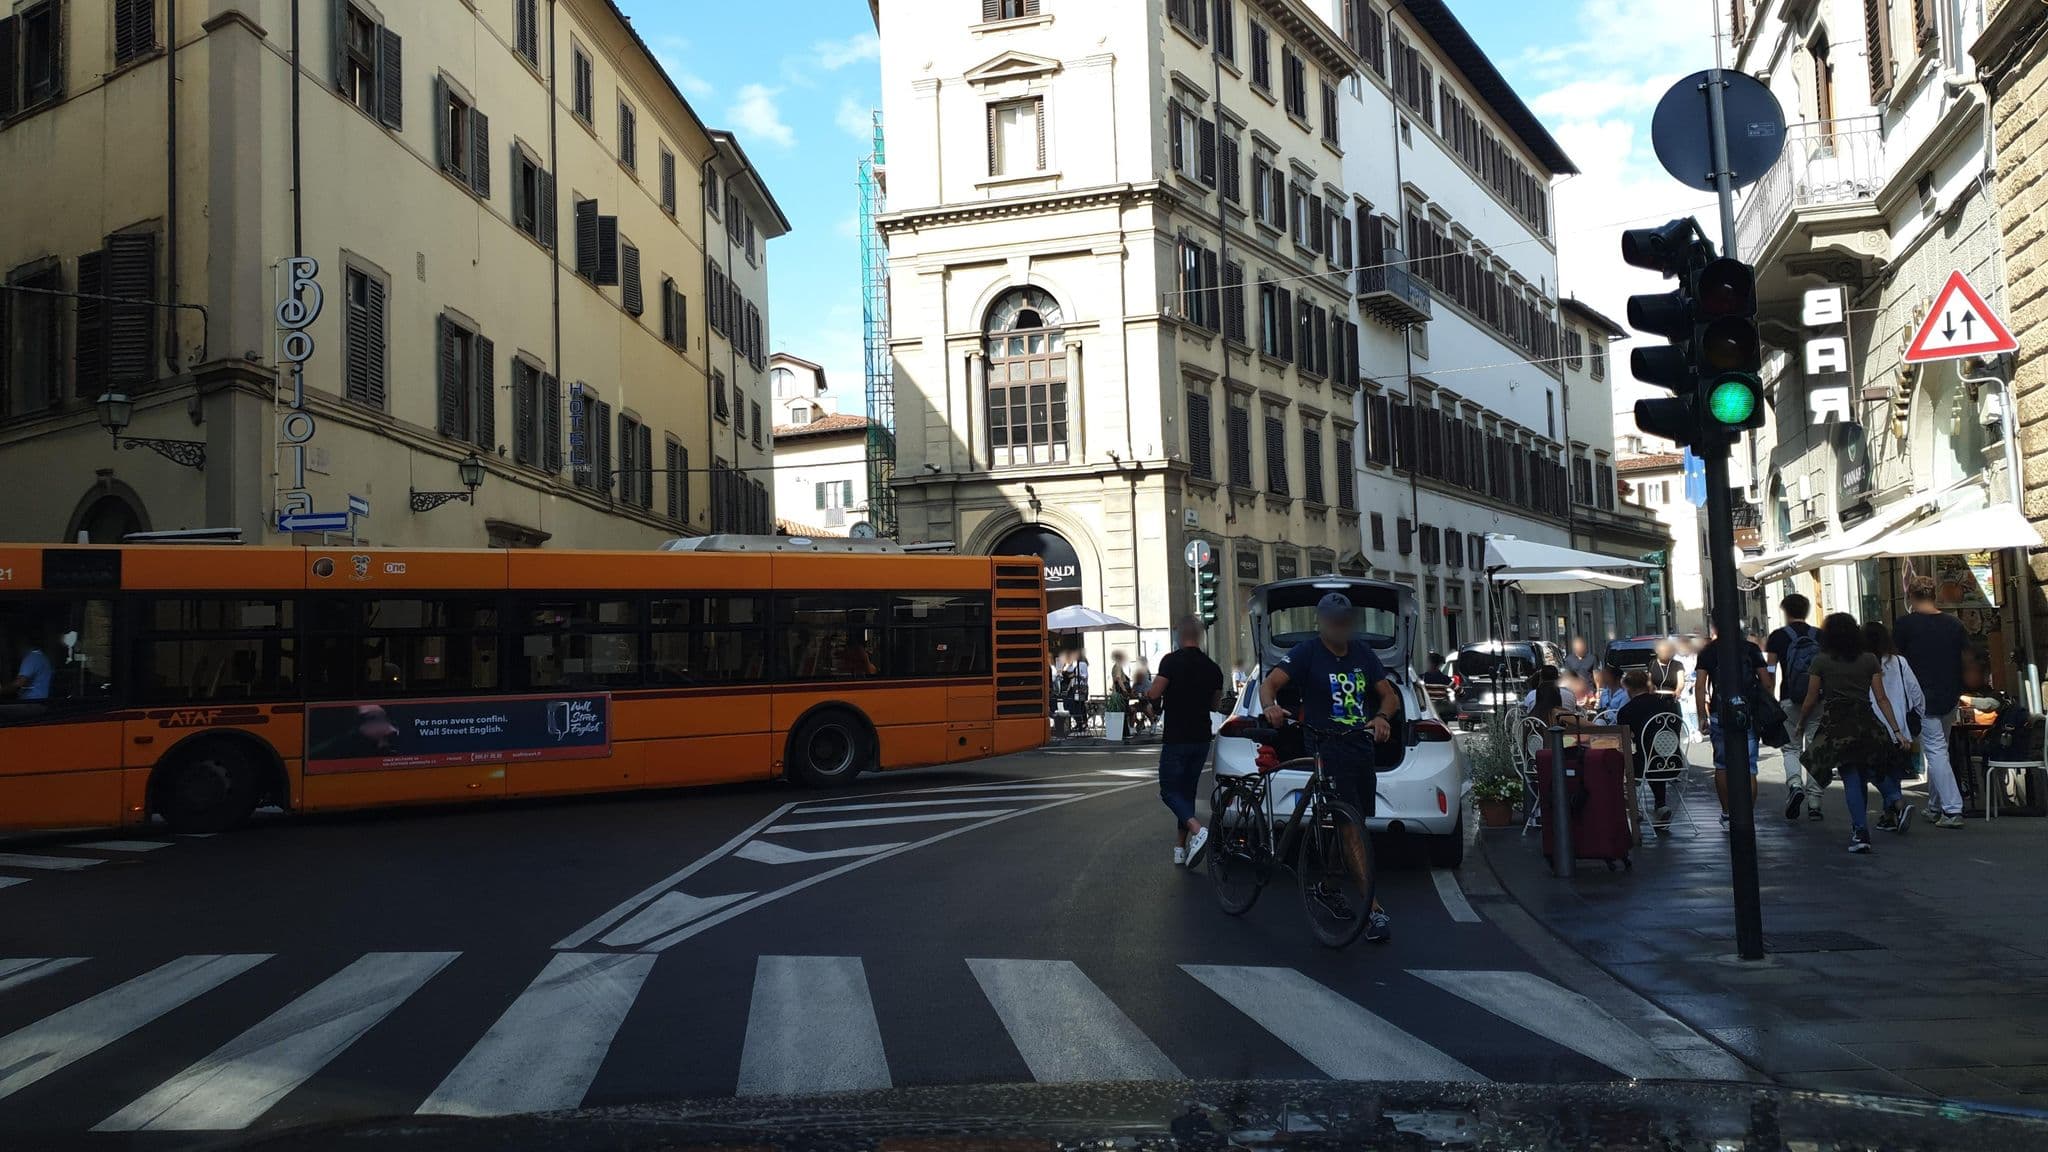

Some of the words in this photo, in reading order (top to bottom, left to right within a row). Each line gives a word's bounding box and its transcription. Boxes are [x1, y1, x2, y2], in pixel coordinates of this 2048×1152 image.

[569, 382, 584, 464] HOTEL
[168, 709, 222, 727] ATAF
[414, 718, 429, 727] Per
[475, 715, 508, 725] confini.
[419, 727, 440, 736] Wall
[441, 726, 468, 736] Street
[469, 725, 503, 737] English.
